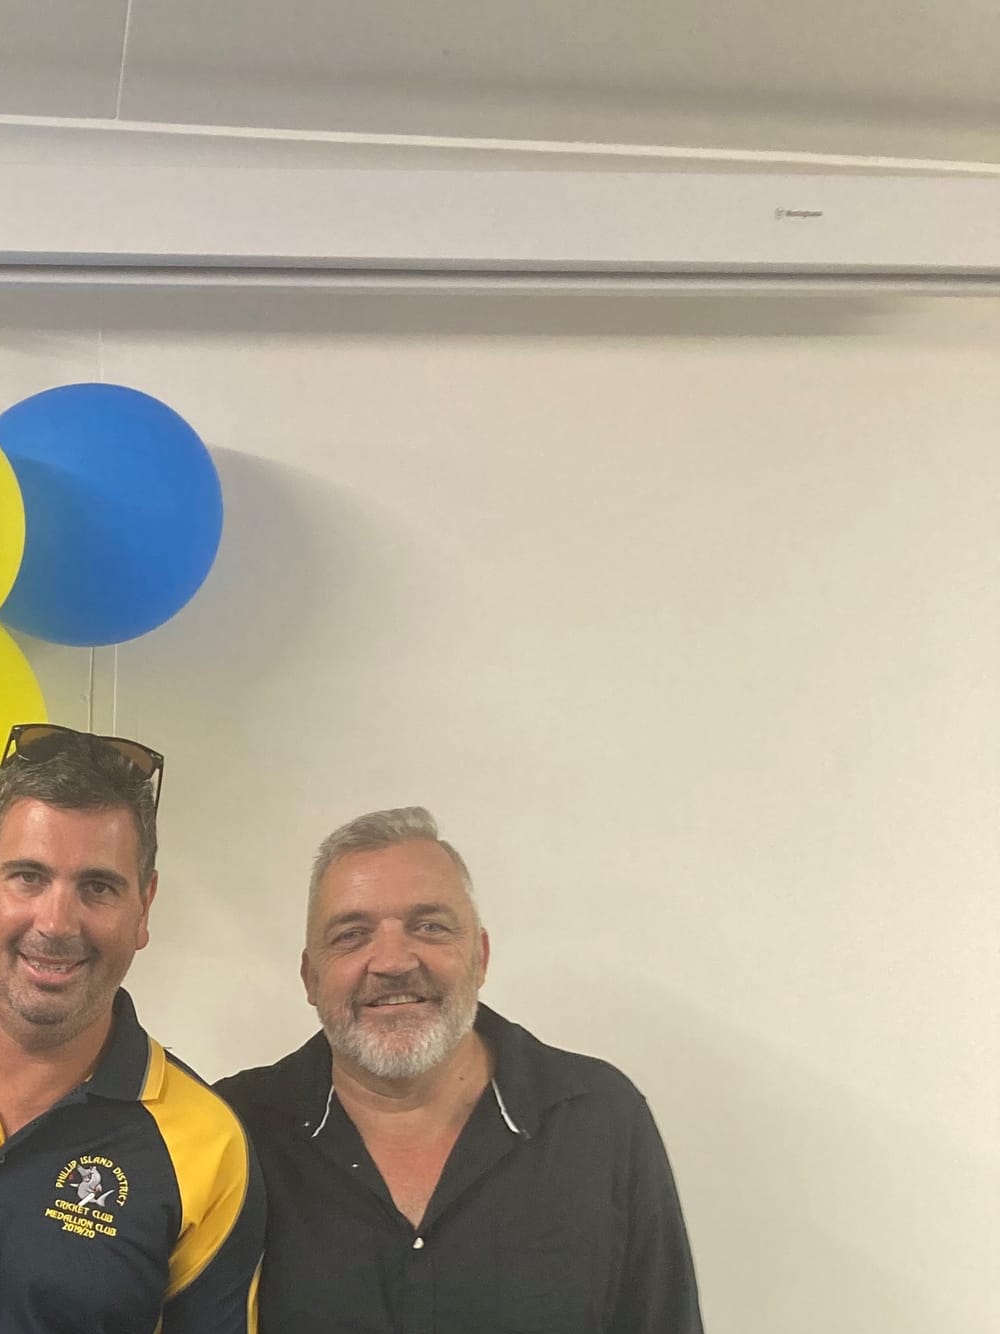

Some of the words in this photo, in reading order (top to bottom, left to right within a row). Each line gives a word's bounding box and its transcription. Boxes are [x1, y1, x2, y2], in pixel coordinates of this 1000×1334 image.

[80, 1155, 114, 1168] ISLAND
[112, 1166, 129, 1207] DISTRICT
[45, 1208, 94, 1229] MEDALLION
[95, 1223, 117, 1237] CLUB
[55, 1199, 90, 1215] CRICKET
[92, 1210, 114, 1223] CLUB
[61, 1222, 96, 1239] 2019/20
